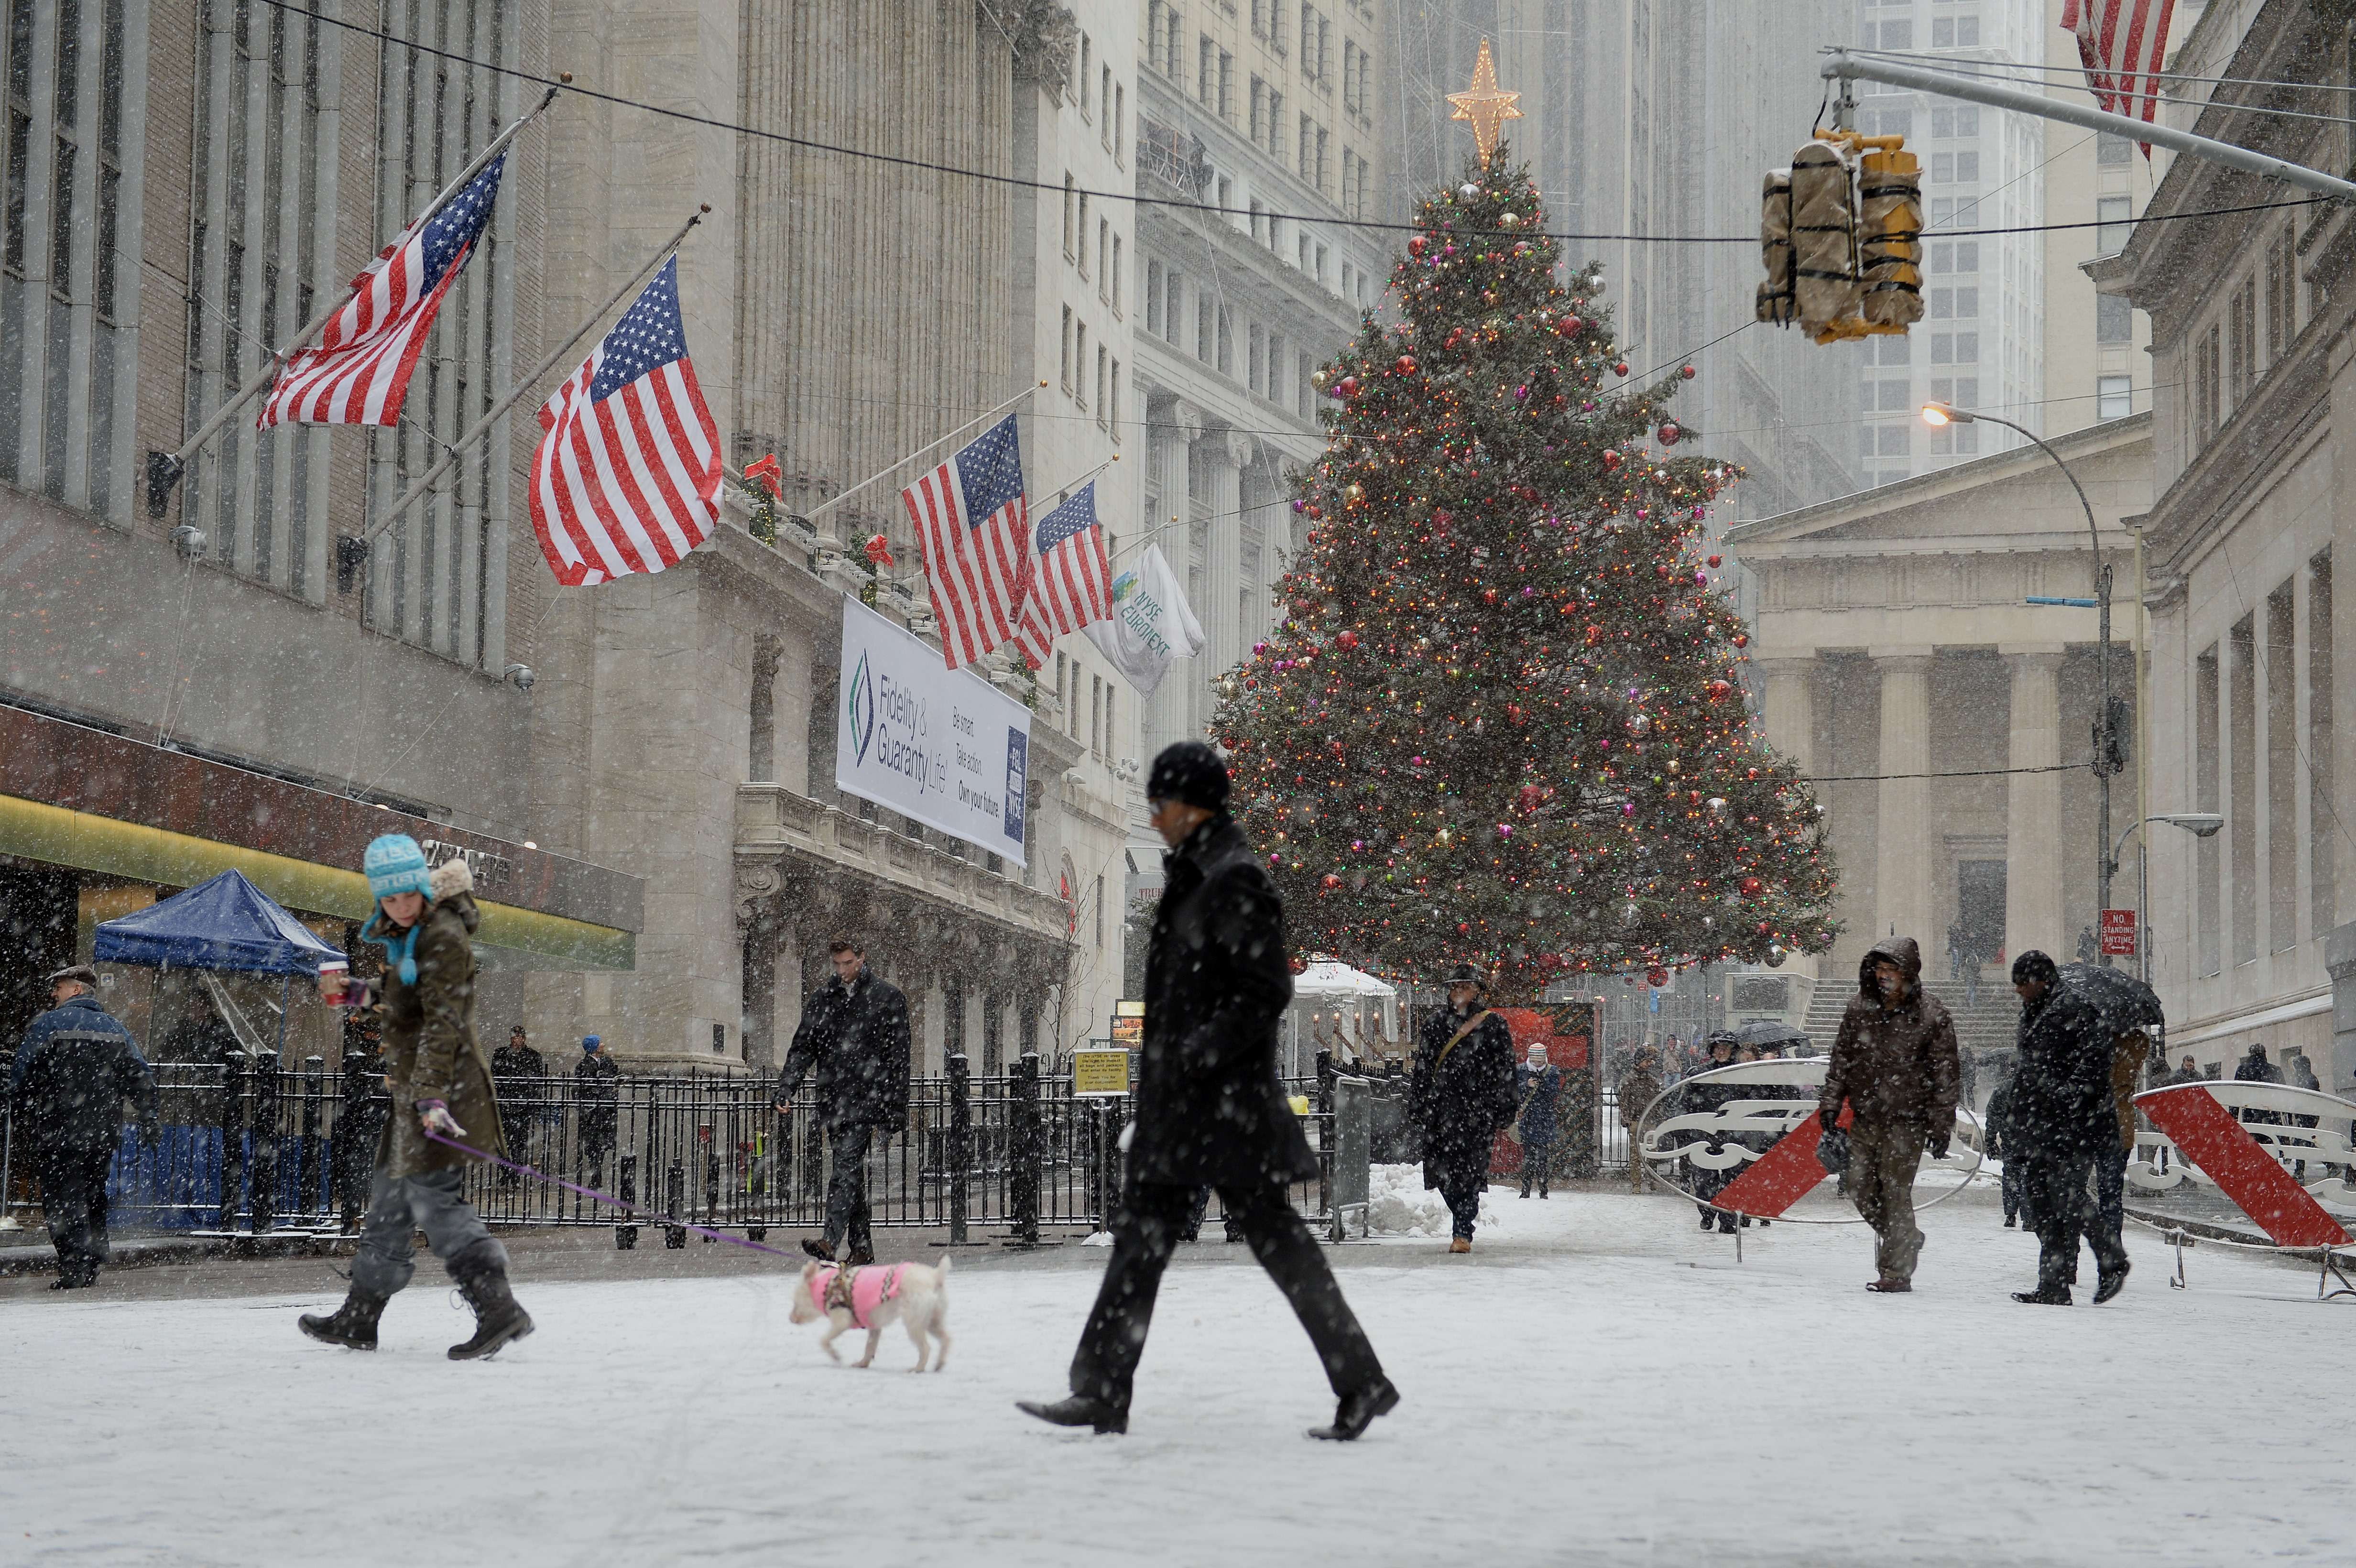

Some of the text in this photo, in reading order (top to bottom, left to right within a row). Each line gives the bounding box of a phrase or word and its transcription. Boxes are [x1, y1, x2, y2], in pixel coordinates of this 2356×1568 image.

[1134, 591, 1163, 622] NYSE
[1121, 605, 1170, 658] EURONEXT
[880, 674, 927, 741] Fidelity &
[953, 706, 974, 738] Be smart.
[878, 722, 928, 795] Guaranty
[956, 742, 982, 776] Take action.
[1012, 747, 1022, 773] FGL
[959, 779, 1000, 818] Own your future.
[1008, 792, 1022, 819] NYSE
[1139, 888, 1163, 899] TRUE
[2113, 914, 2124, 923] NO
